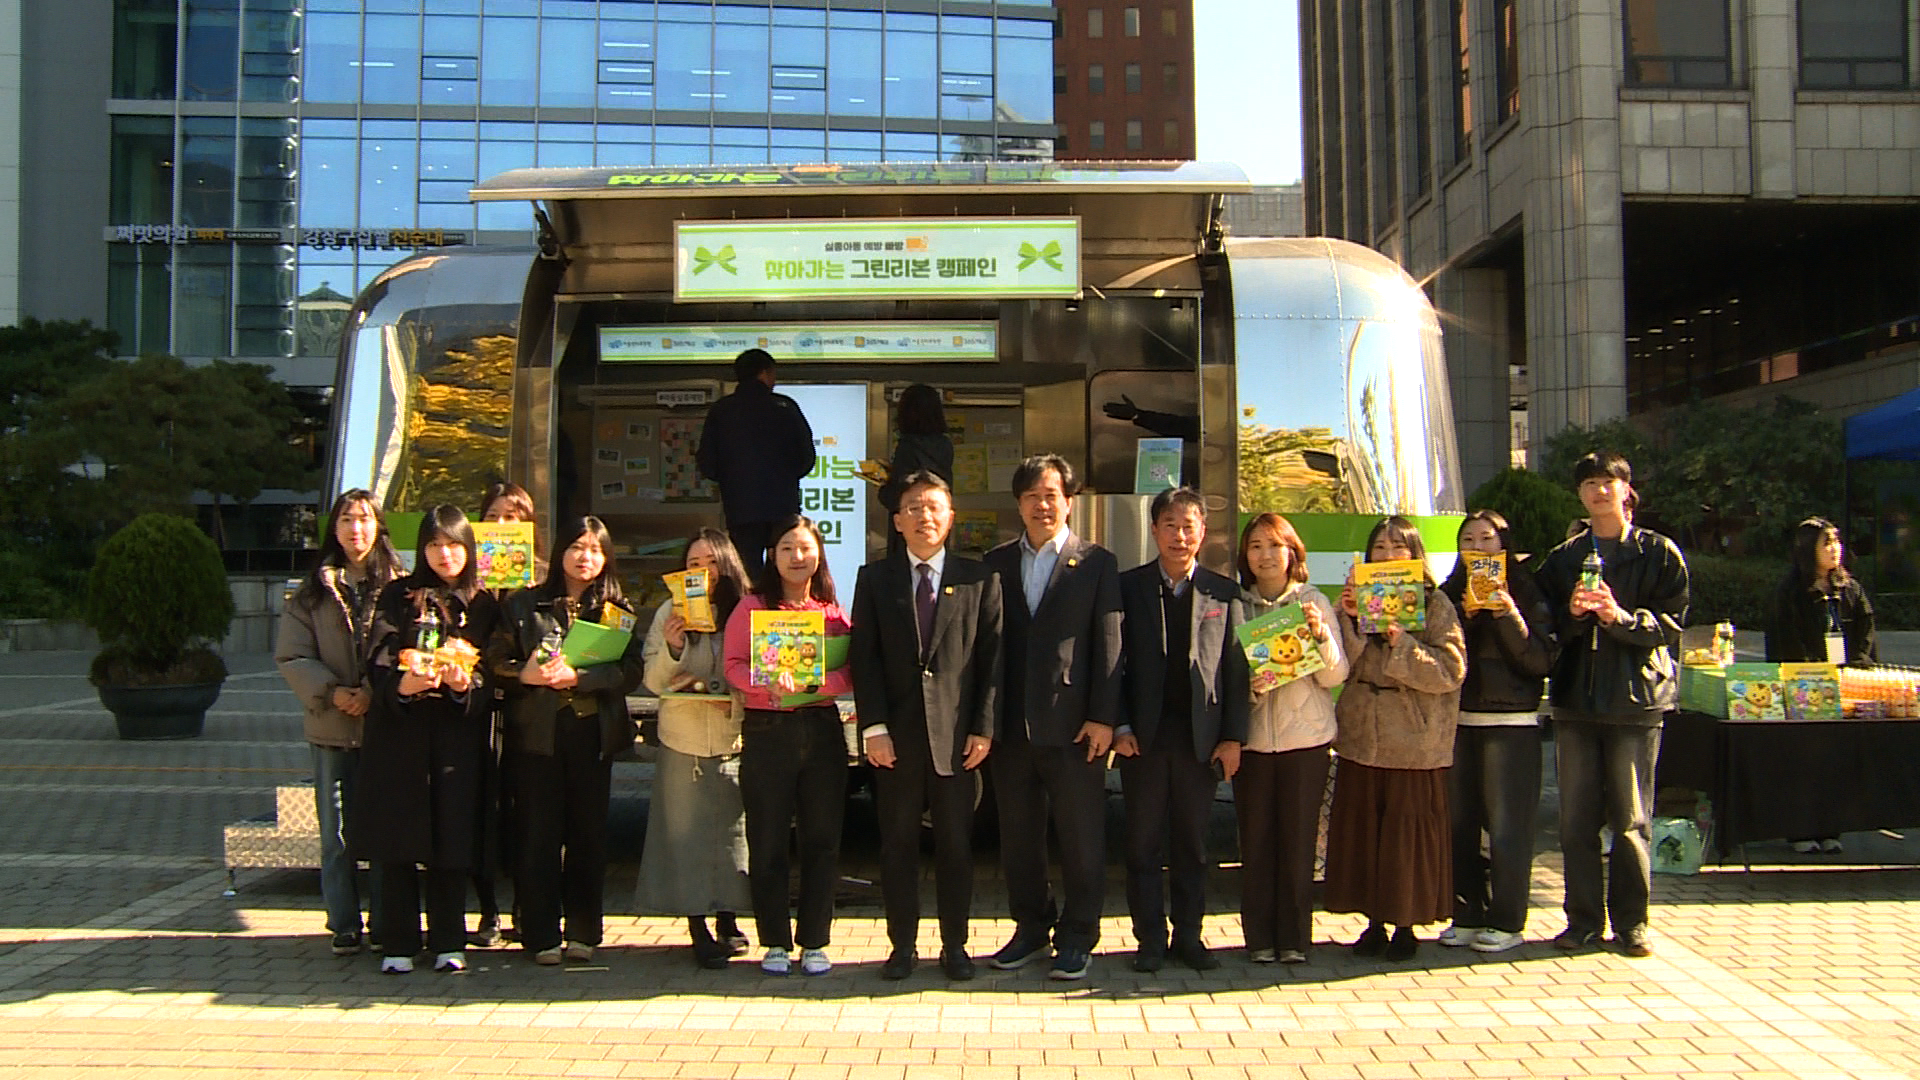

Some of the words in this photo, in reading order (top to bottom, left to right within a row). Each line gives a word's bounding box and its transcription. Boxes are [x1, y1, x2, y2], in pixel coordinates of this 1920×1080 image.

[825, 241, 861, 252] 실종아동
[863, 241, 883, 251] 예방
[765, 259, 845, 281] 찾아가는
[850, 258, 931, 279] 그린리본
[936, 257, 997, 278] 캠페인
[807, 455, 856, 480] 가는
[800, 487, 856, 512] 리본
